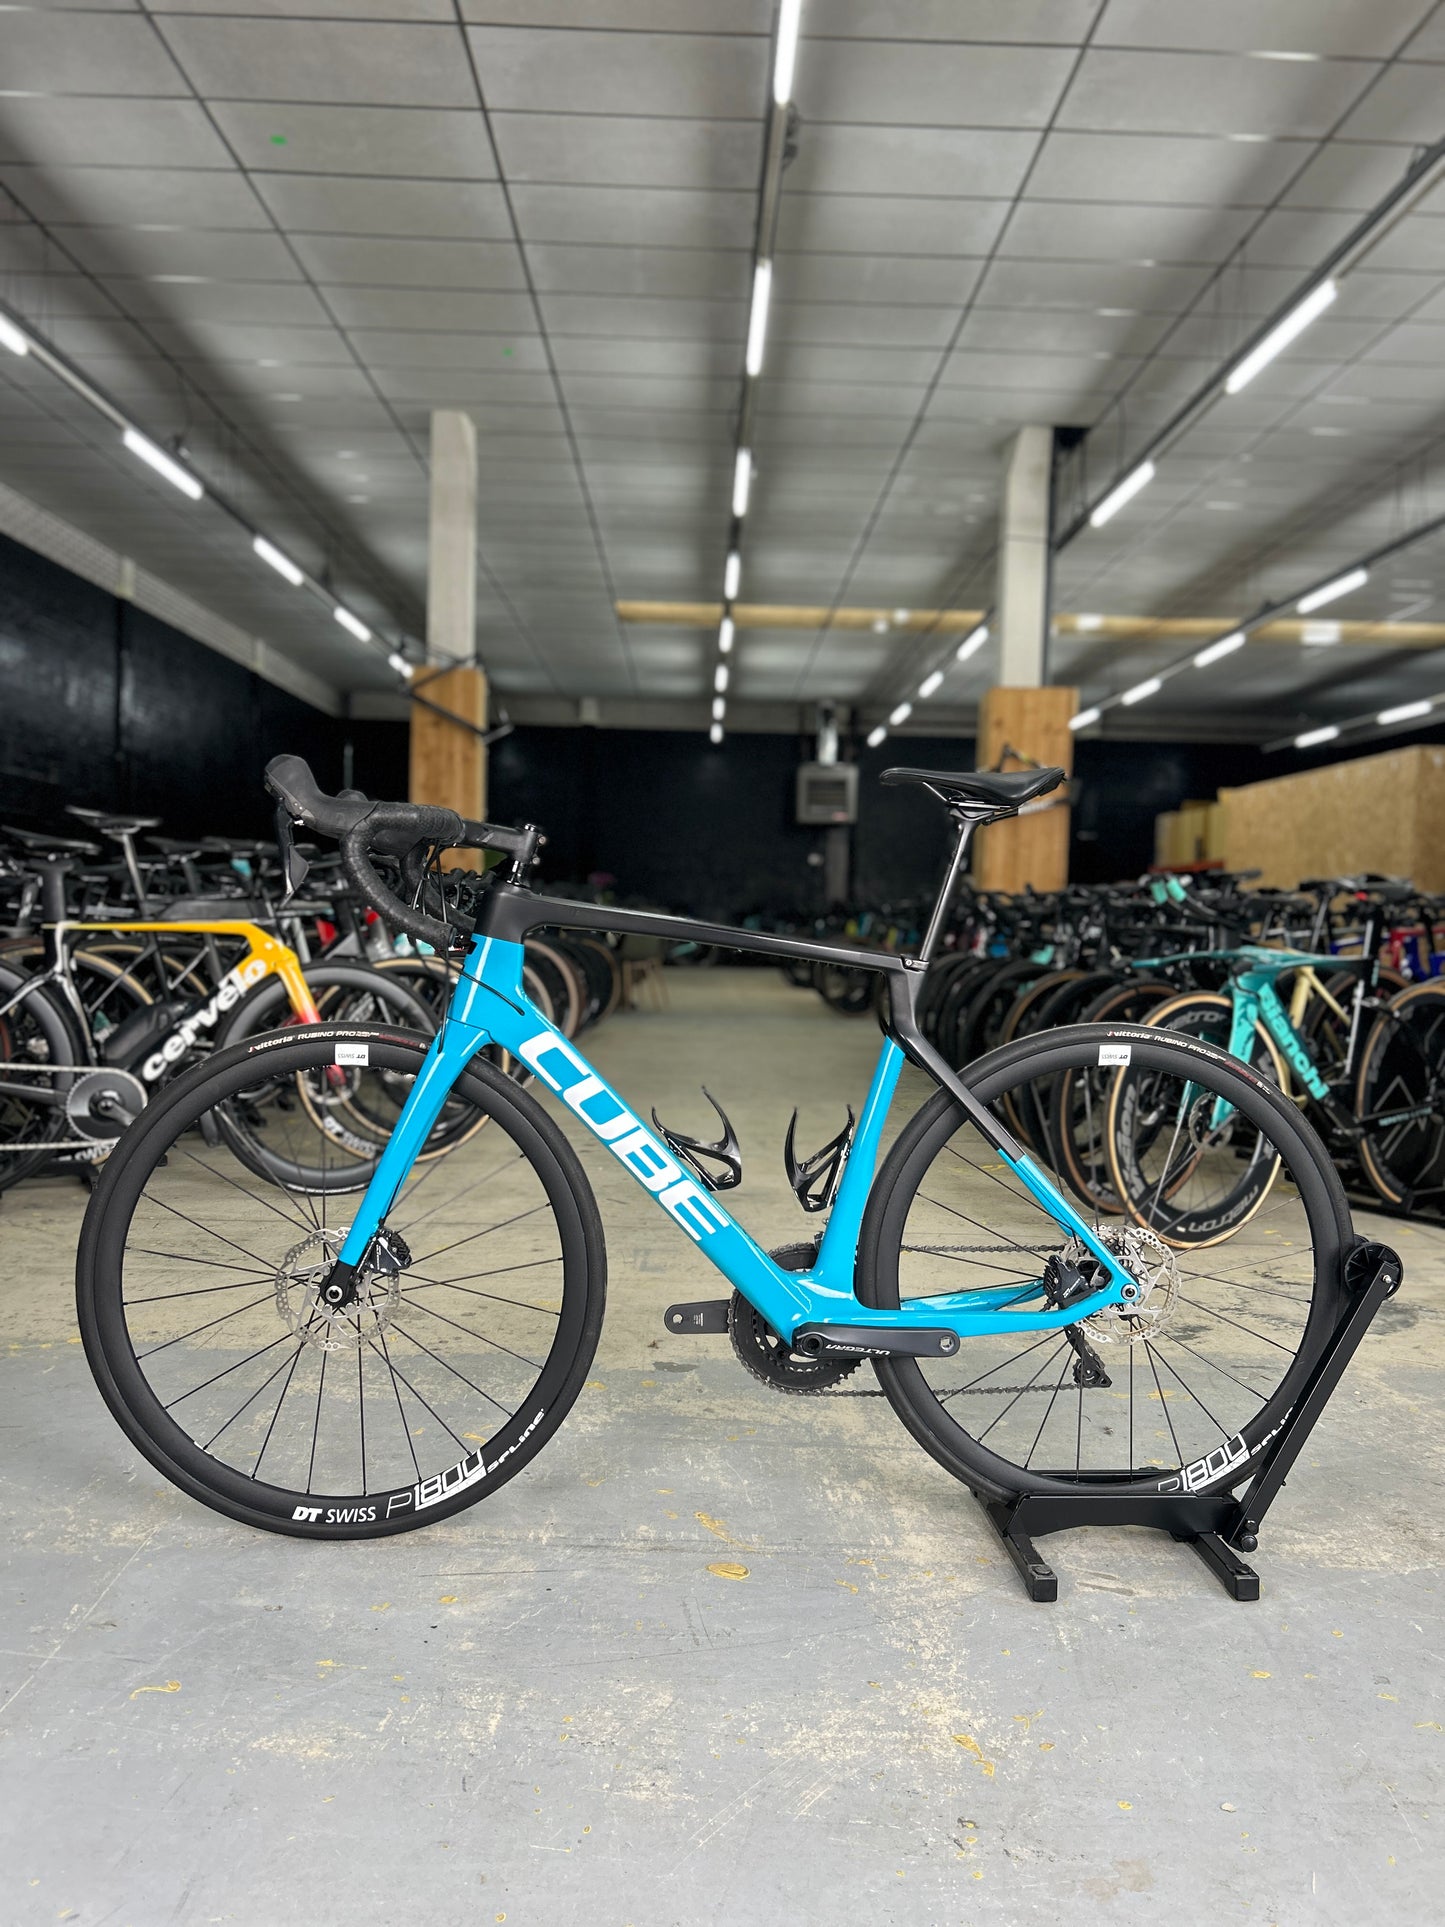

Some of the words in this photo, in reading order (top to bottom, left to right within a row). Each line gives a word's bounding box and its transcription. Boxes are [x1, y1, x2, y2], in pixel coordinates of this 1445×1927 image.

[297, 1031, 334, 1040] RUBINO
[1154, 1035, 1188, 1048] RUBINO
[1257, 983, 1330, 1100] Bianchi
[519, 1031, 730, 1241] CUBE
[826, 1344, 891, 1355] ULTEGRA
[292, 1506, 323, 1522] DT
[325, 1506, 376, 1523] SWISS
[386, 1448, 485, 1518] P1800
